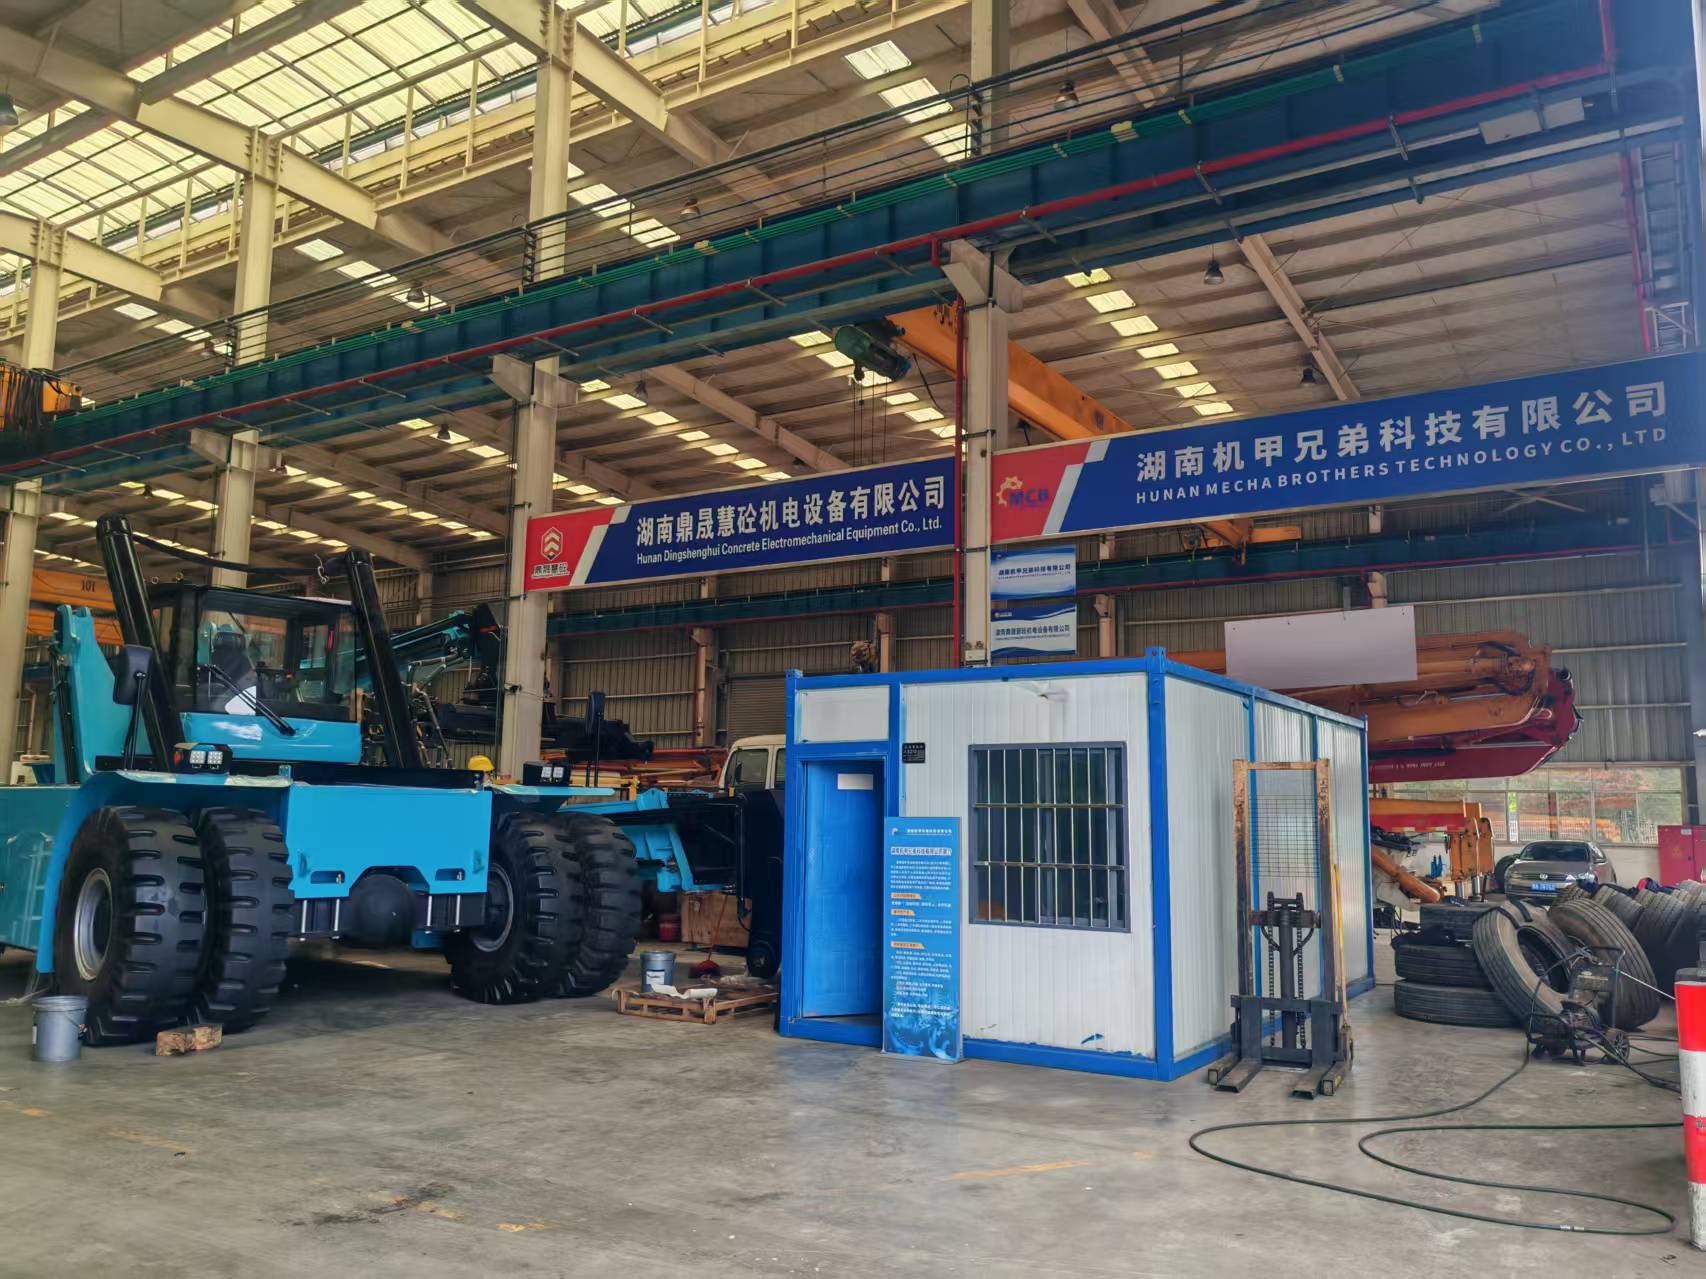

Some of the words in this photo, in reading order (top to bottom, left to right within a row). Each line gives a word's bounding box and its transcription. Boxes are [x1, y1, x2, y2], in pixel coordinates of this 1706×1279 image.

[1137, 381, 1666, 482] 湖南机甲兄弟科技有限公司
[1009, 488, 1049, 511] MCB
[1136, 485, 1200, 504] HUNAN
[1206, 477, 1272, 496] MECHA
[1278, 464, 1389, 487] BROTHERS
[1395, 442, 1553, 474] TECHNOLOGY
[636, 475, 945, 546] 湖南鼎晟慧砼机电设备有限公司
[637, 552, 662, 564] Hunan
[664, 544, 721, 562] Dingshenghui
[722, 541, 760, 555] Concrete
[762, 527, 844, 550] Electromechanical
[846, 522, 899, 542] Equipment
[901, 519, 920, 533] Co.,
[923, 515, 942, 531] Ltd.
